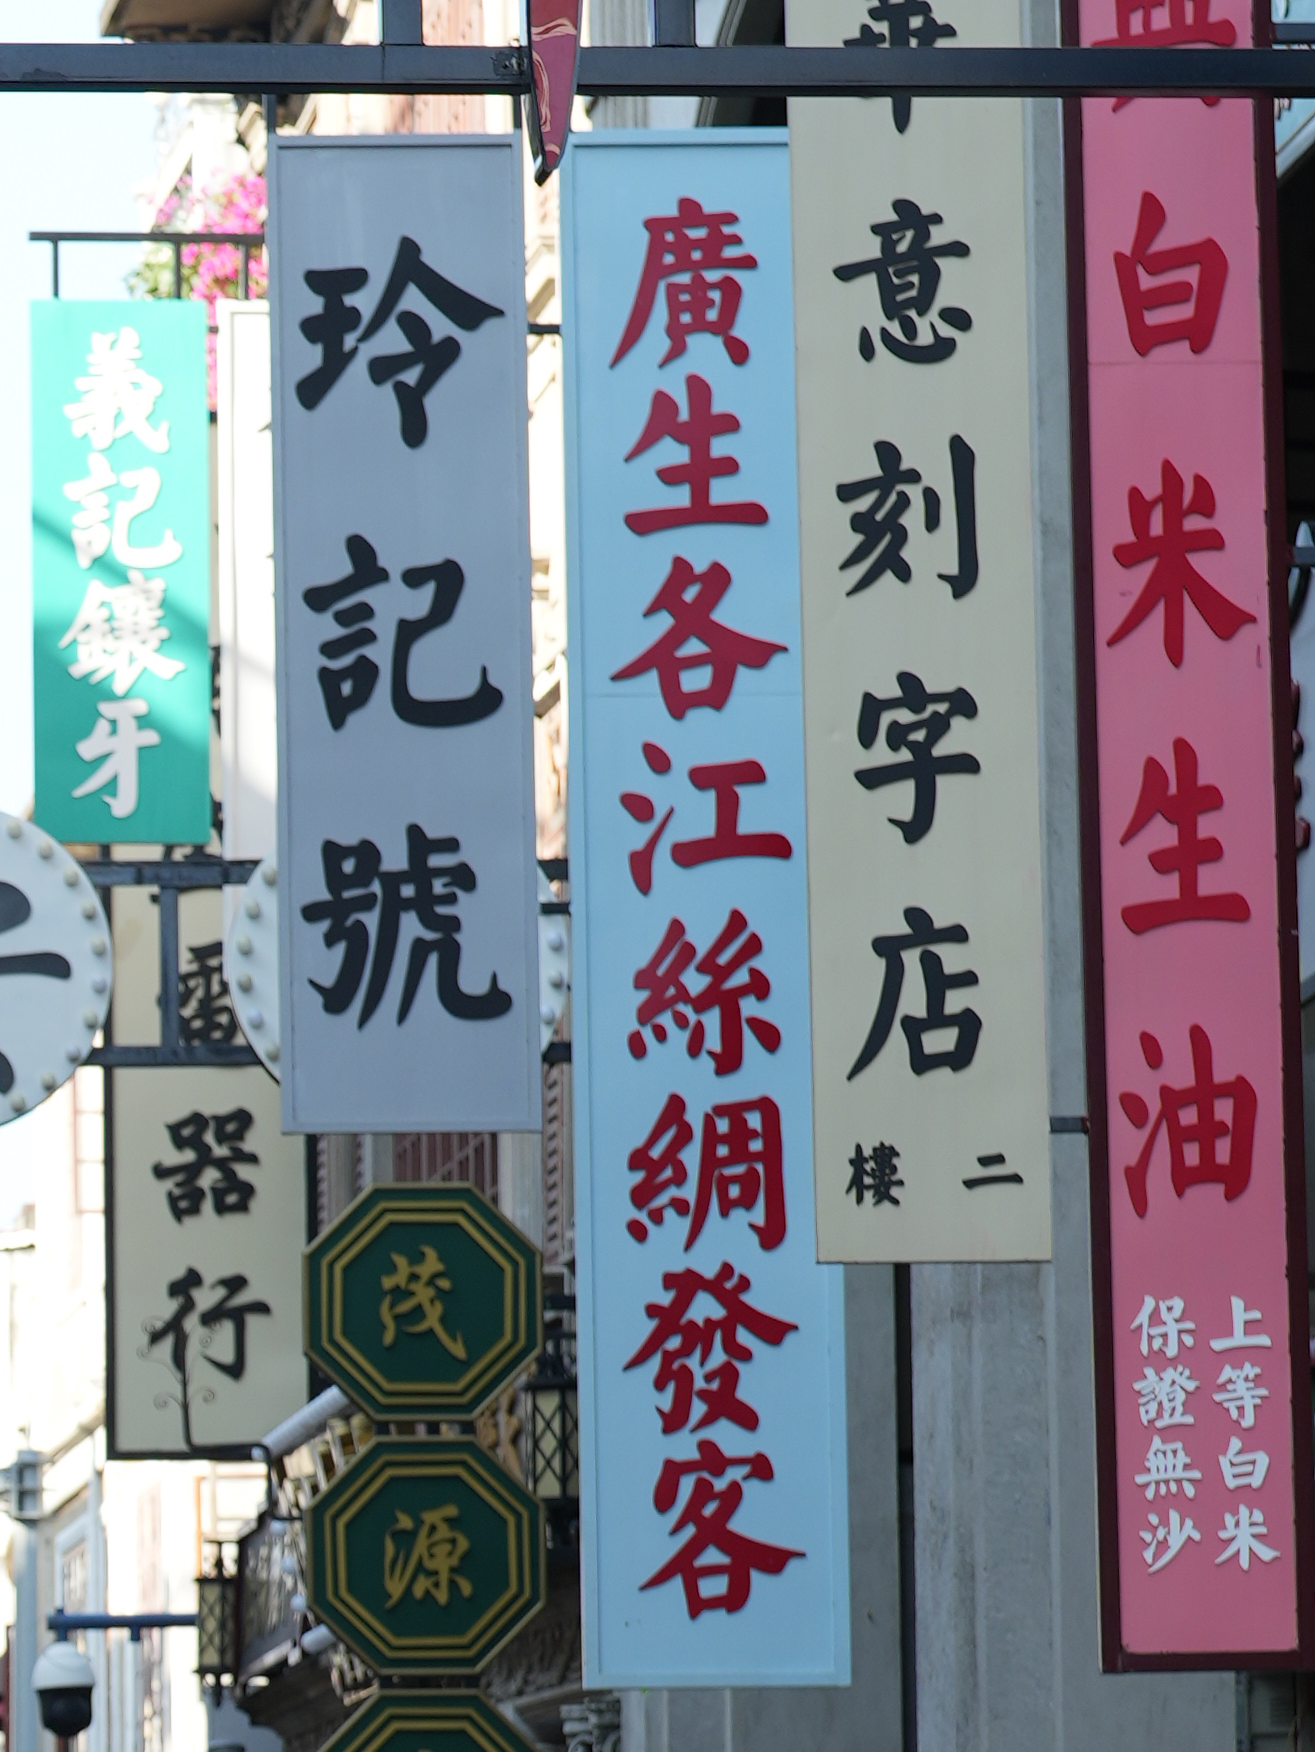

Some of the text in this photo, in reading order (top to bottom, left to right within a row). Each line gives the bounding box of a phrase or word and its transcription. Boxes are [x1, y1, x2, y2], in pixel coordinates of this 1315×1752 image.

[59, 324, 188, 822] 義記鑲牙
[294, 234, 515, 1031] 玲記號
[609, 194, 807, 1620] 廣生各江絲綢發客
[1130, 1293, 1201, 1574] 保證無沙
[1209, 1296, 1279, 1571] 上等白米
